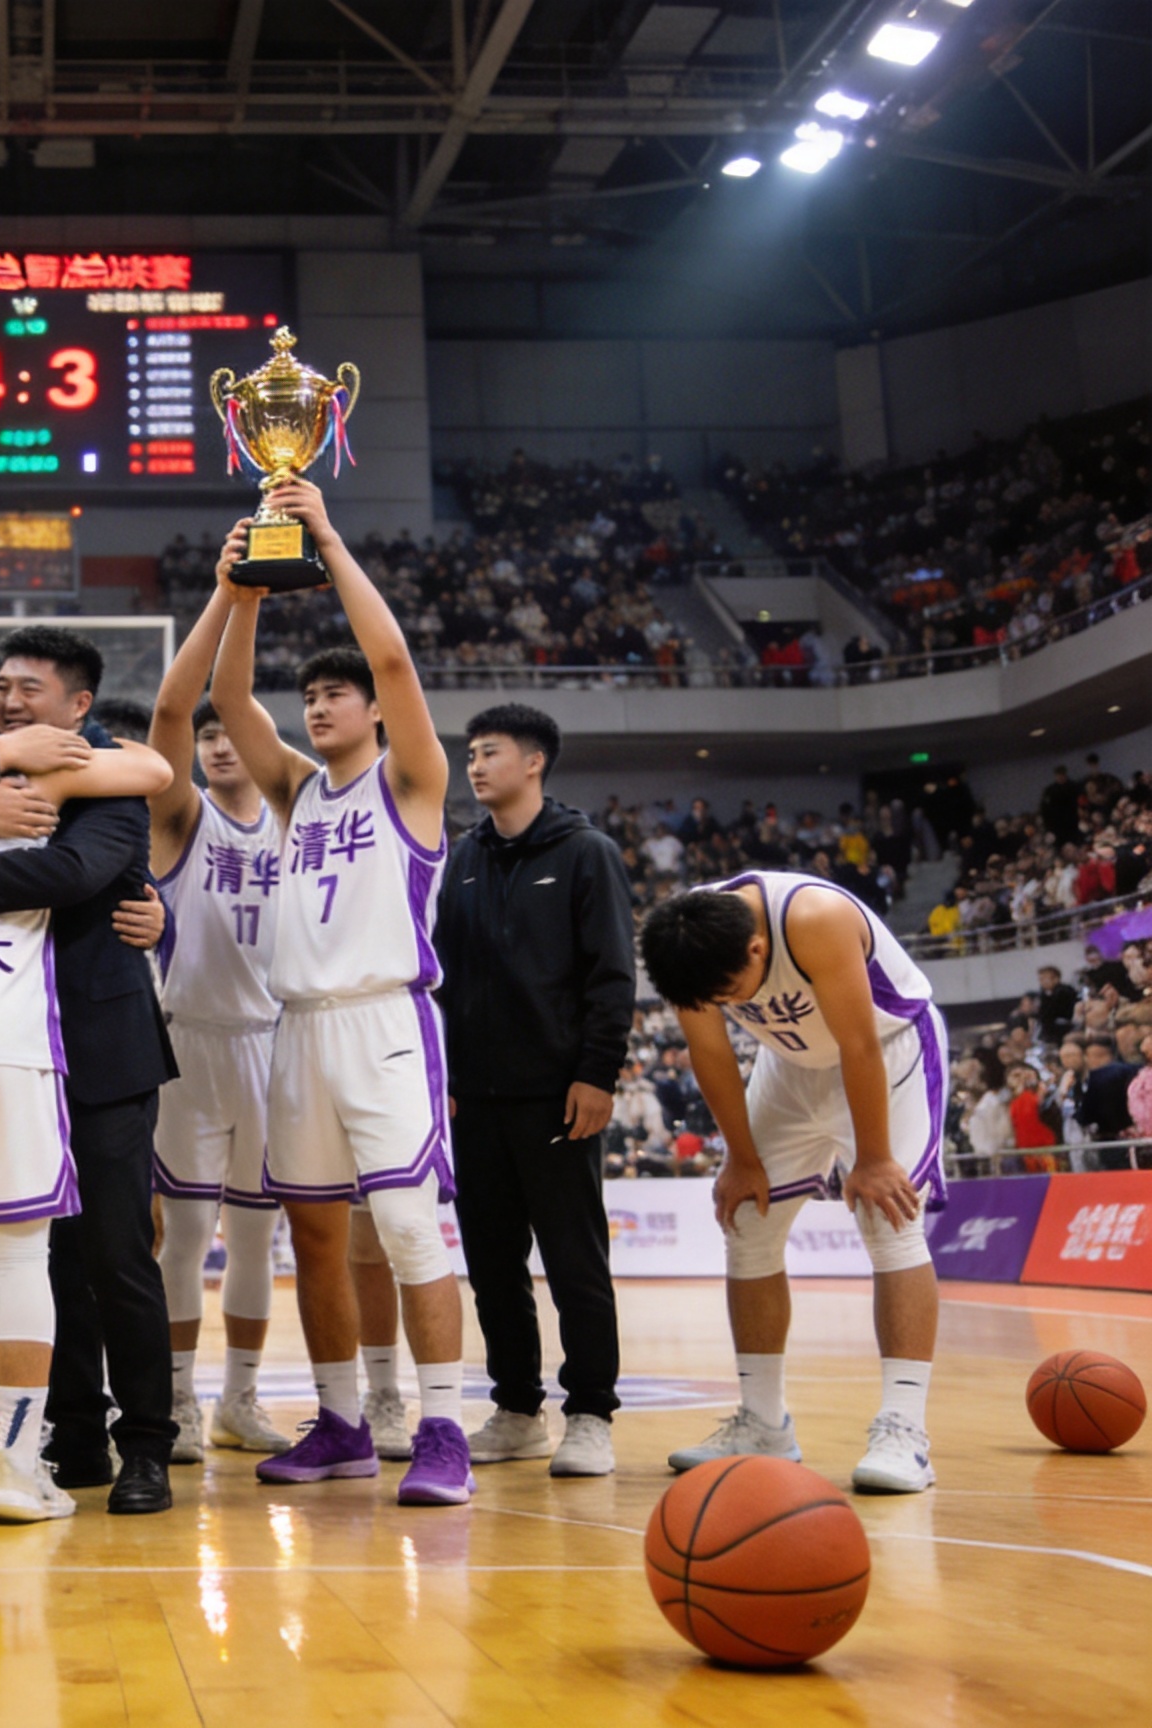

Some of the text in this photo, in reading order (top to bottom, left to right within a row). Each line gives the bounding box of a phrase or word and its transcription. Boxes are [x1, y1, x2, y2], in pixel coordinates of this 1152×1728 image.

[204, 842, 280, 896] 清华
[290, 810, 376, 875] 清华
[317, 874, 339, 924] 7
